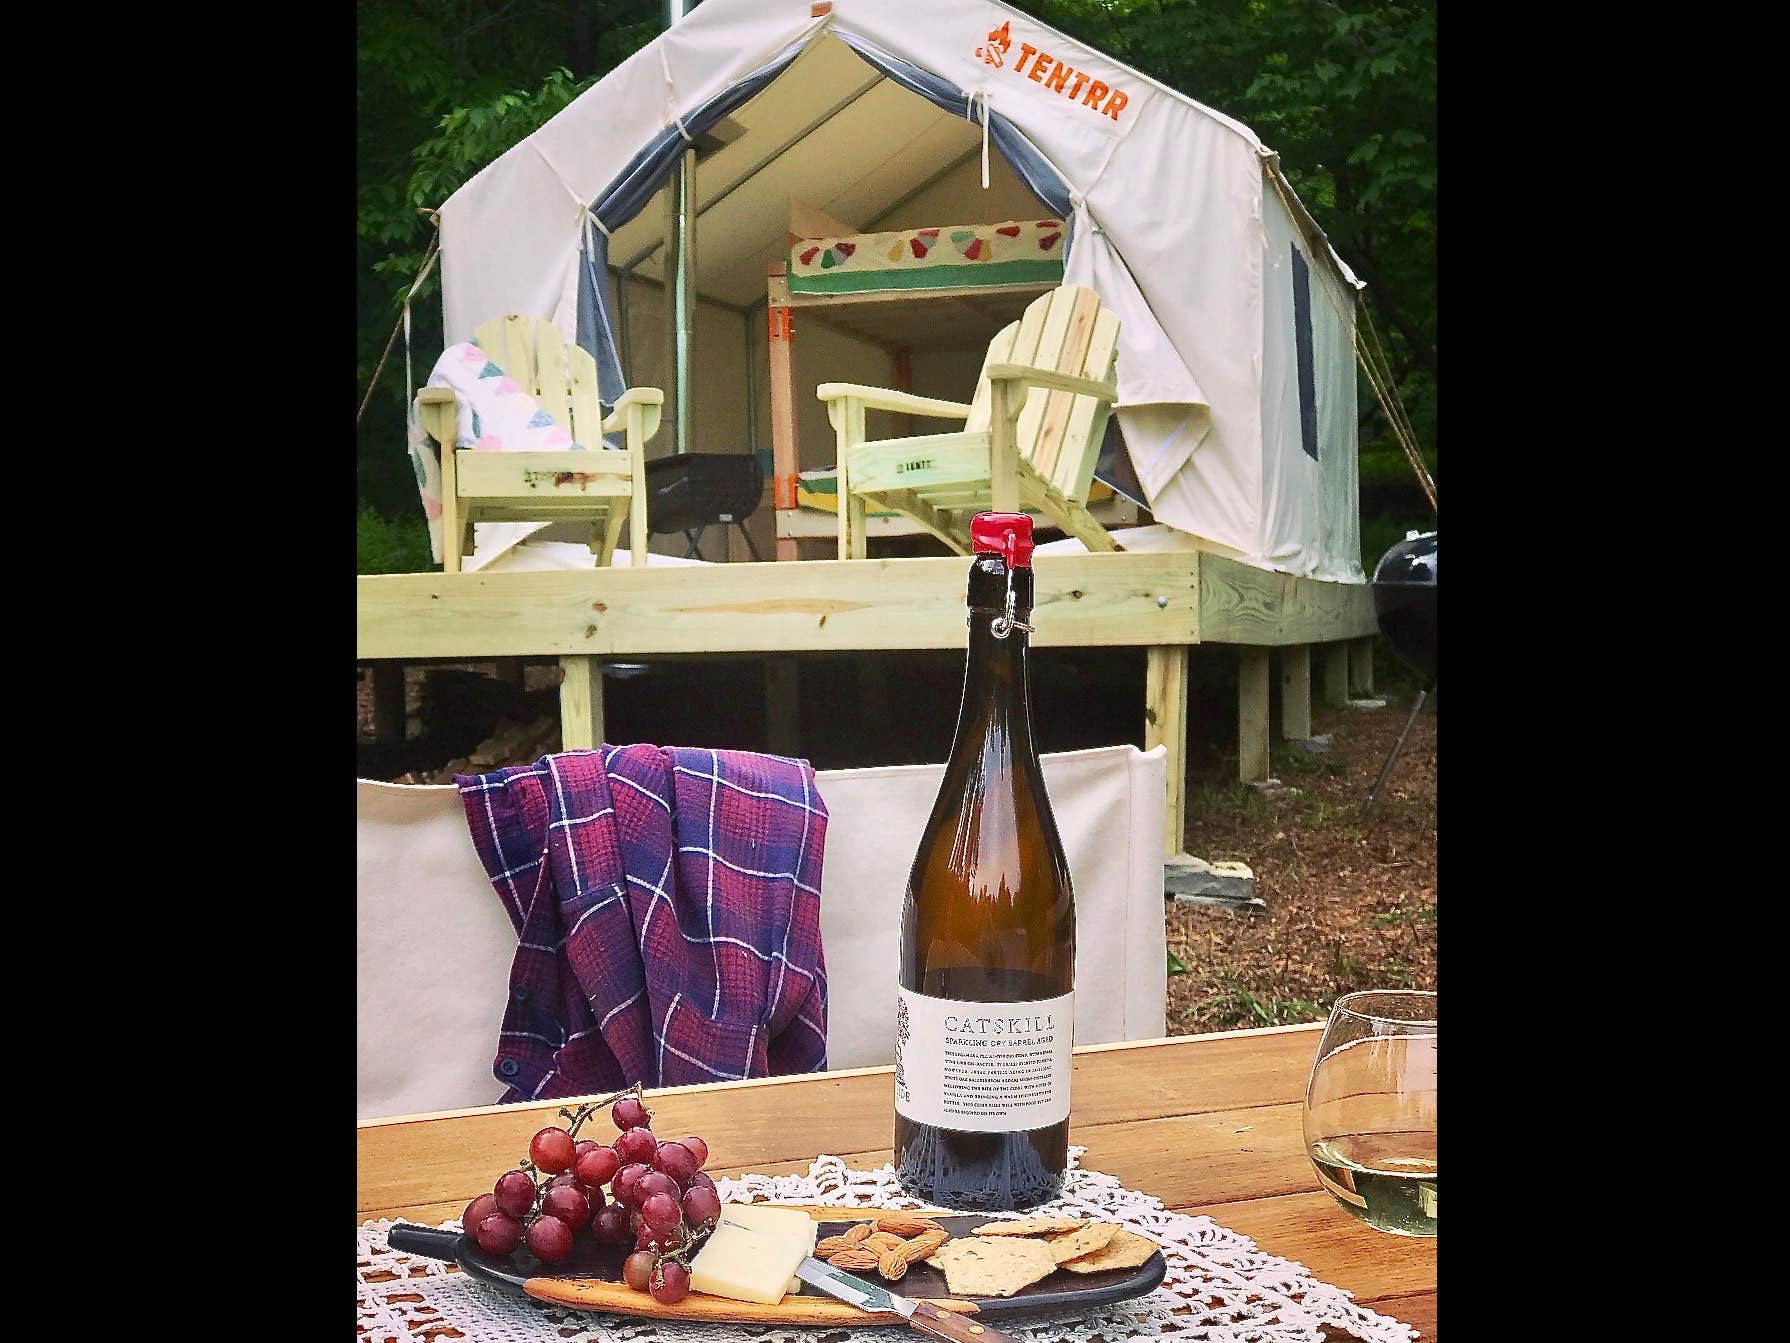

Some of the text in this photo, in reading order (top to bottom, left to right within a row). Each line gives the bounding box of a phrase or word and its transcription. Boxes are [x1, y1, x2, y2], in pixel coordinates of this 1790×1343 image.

[1013, 42, 1129, 121] TENTRR
[944, 1014, 1055, 1034] CATSKILL
[945, 1037, 989, 1047] SPARKLING
[1008, 1039, 1036, 1047] BARREL
[1037, 1035, 1054, 1045] AGED
